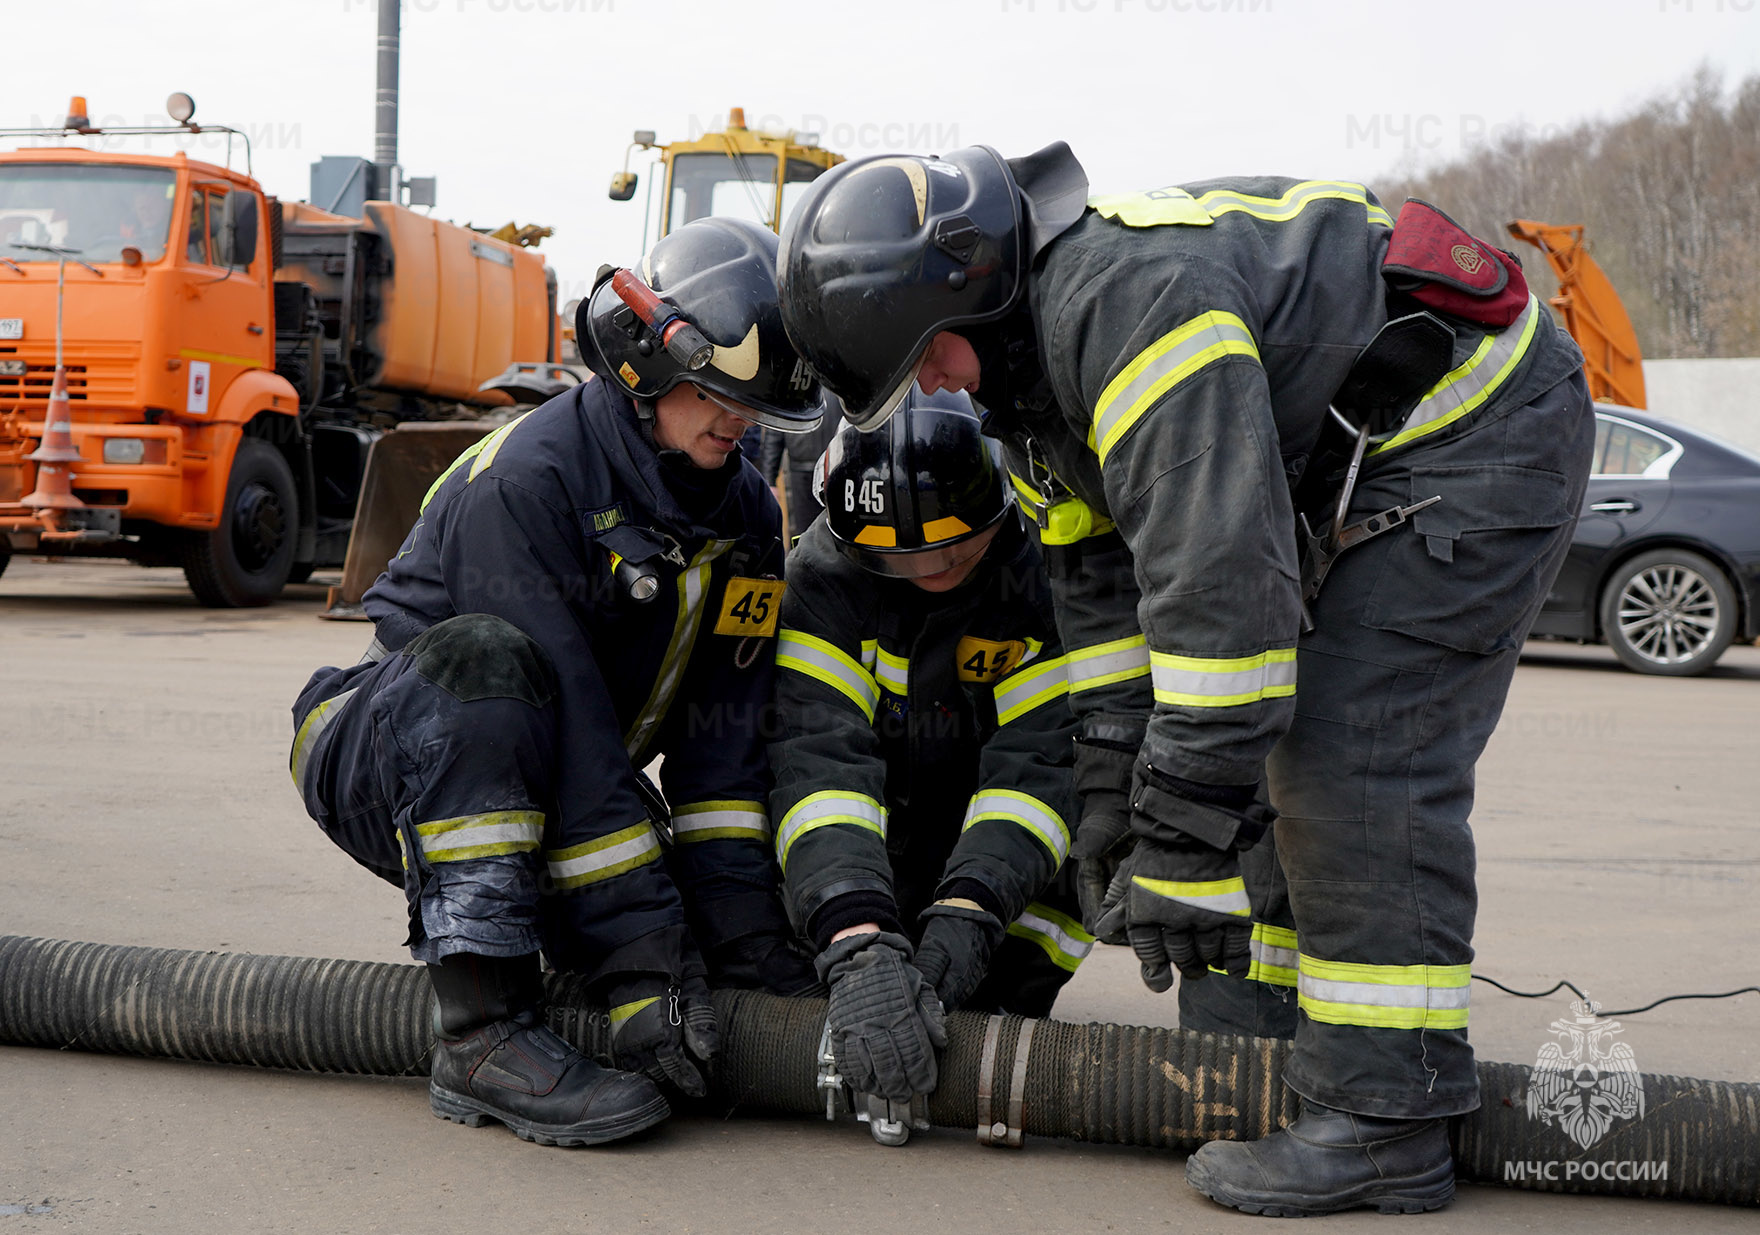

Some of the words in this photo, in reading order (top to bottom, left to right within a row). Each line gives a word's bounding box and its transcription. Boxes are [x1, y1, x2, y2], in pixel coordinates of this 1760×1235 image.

[789, 357, 814, 391] 45
[858, 480, 885, 514] 45
[730, 590, 773, 624] 45
[963, 647, 1010, 677] 45
